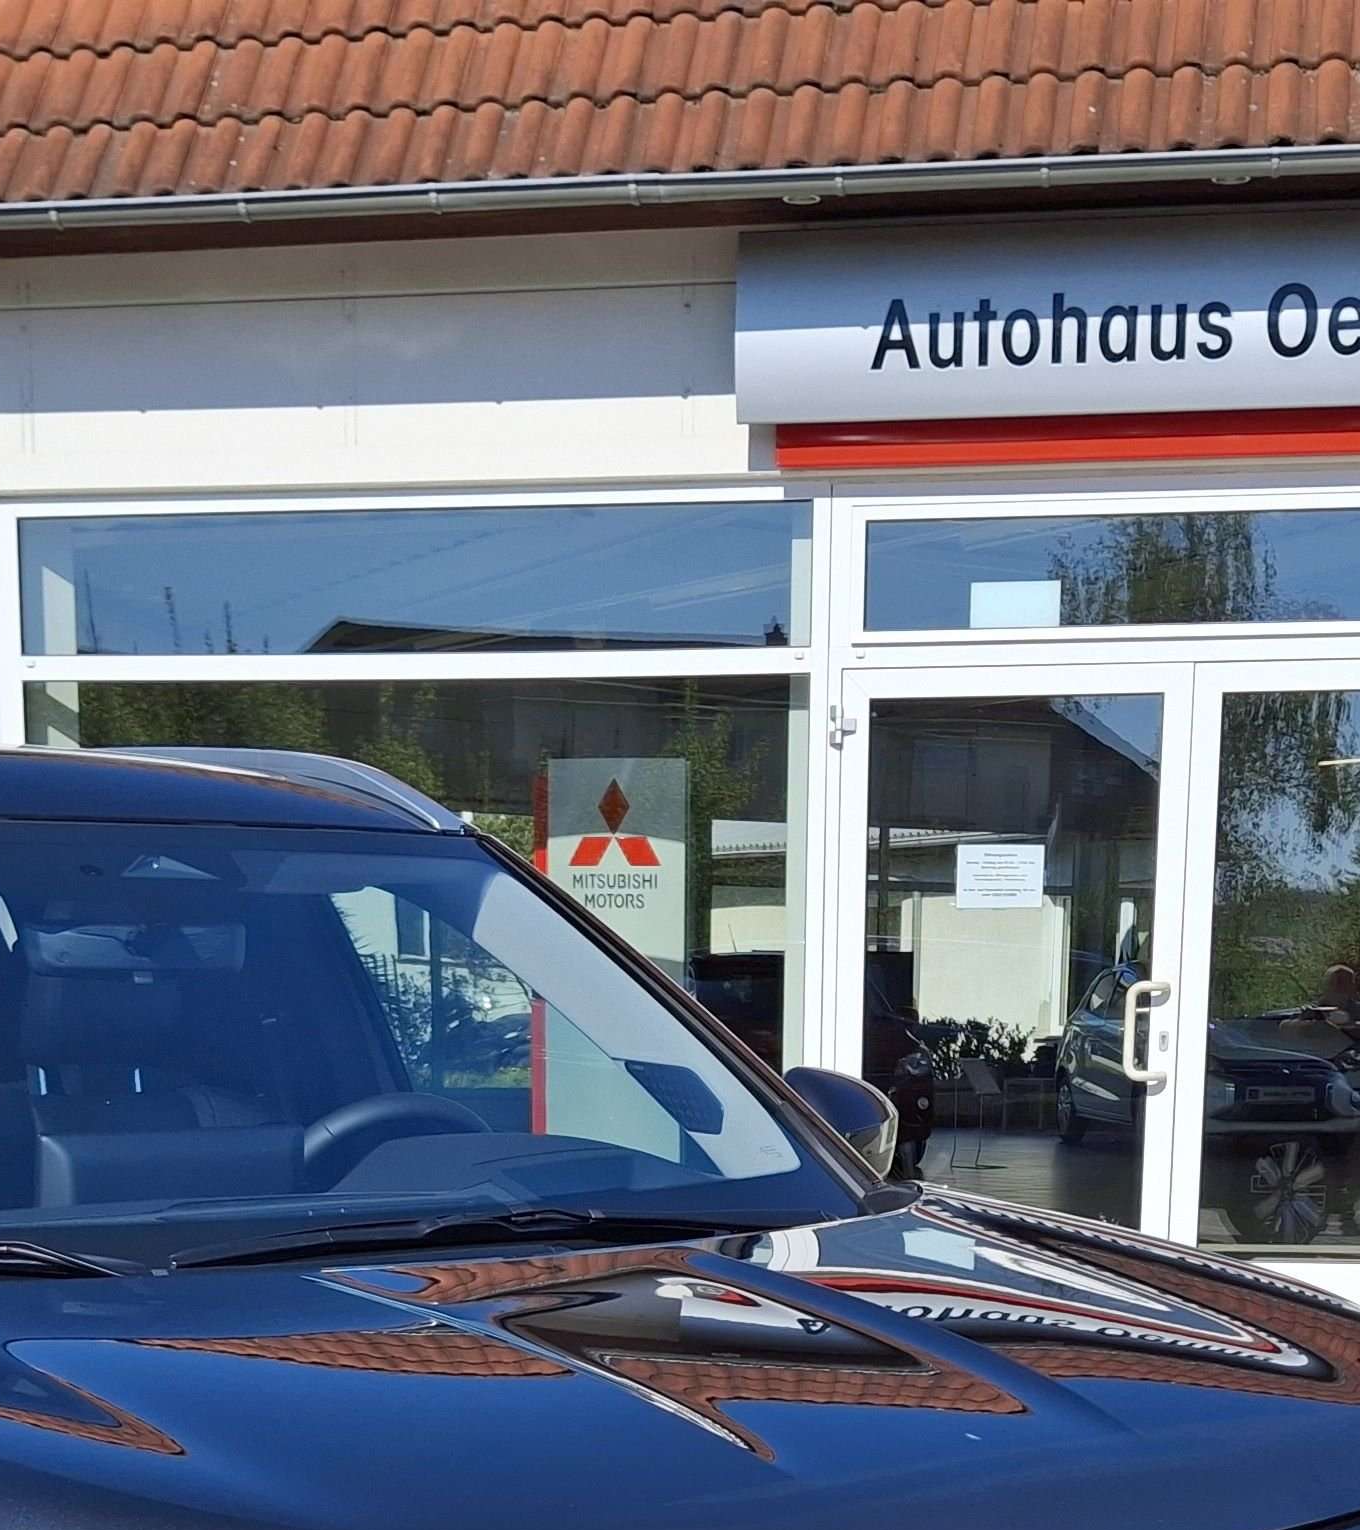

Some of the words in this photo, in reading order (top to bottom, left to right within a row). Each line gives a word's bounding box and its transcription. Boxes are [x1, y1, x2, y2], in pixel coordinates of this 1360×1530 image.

[870, 292, 1233, 370] Autohaus
[572, 873, 658, 889] MITSUBISHI
[584, 893, 645, 909] MOTORS
